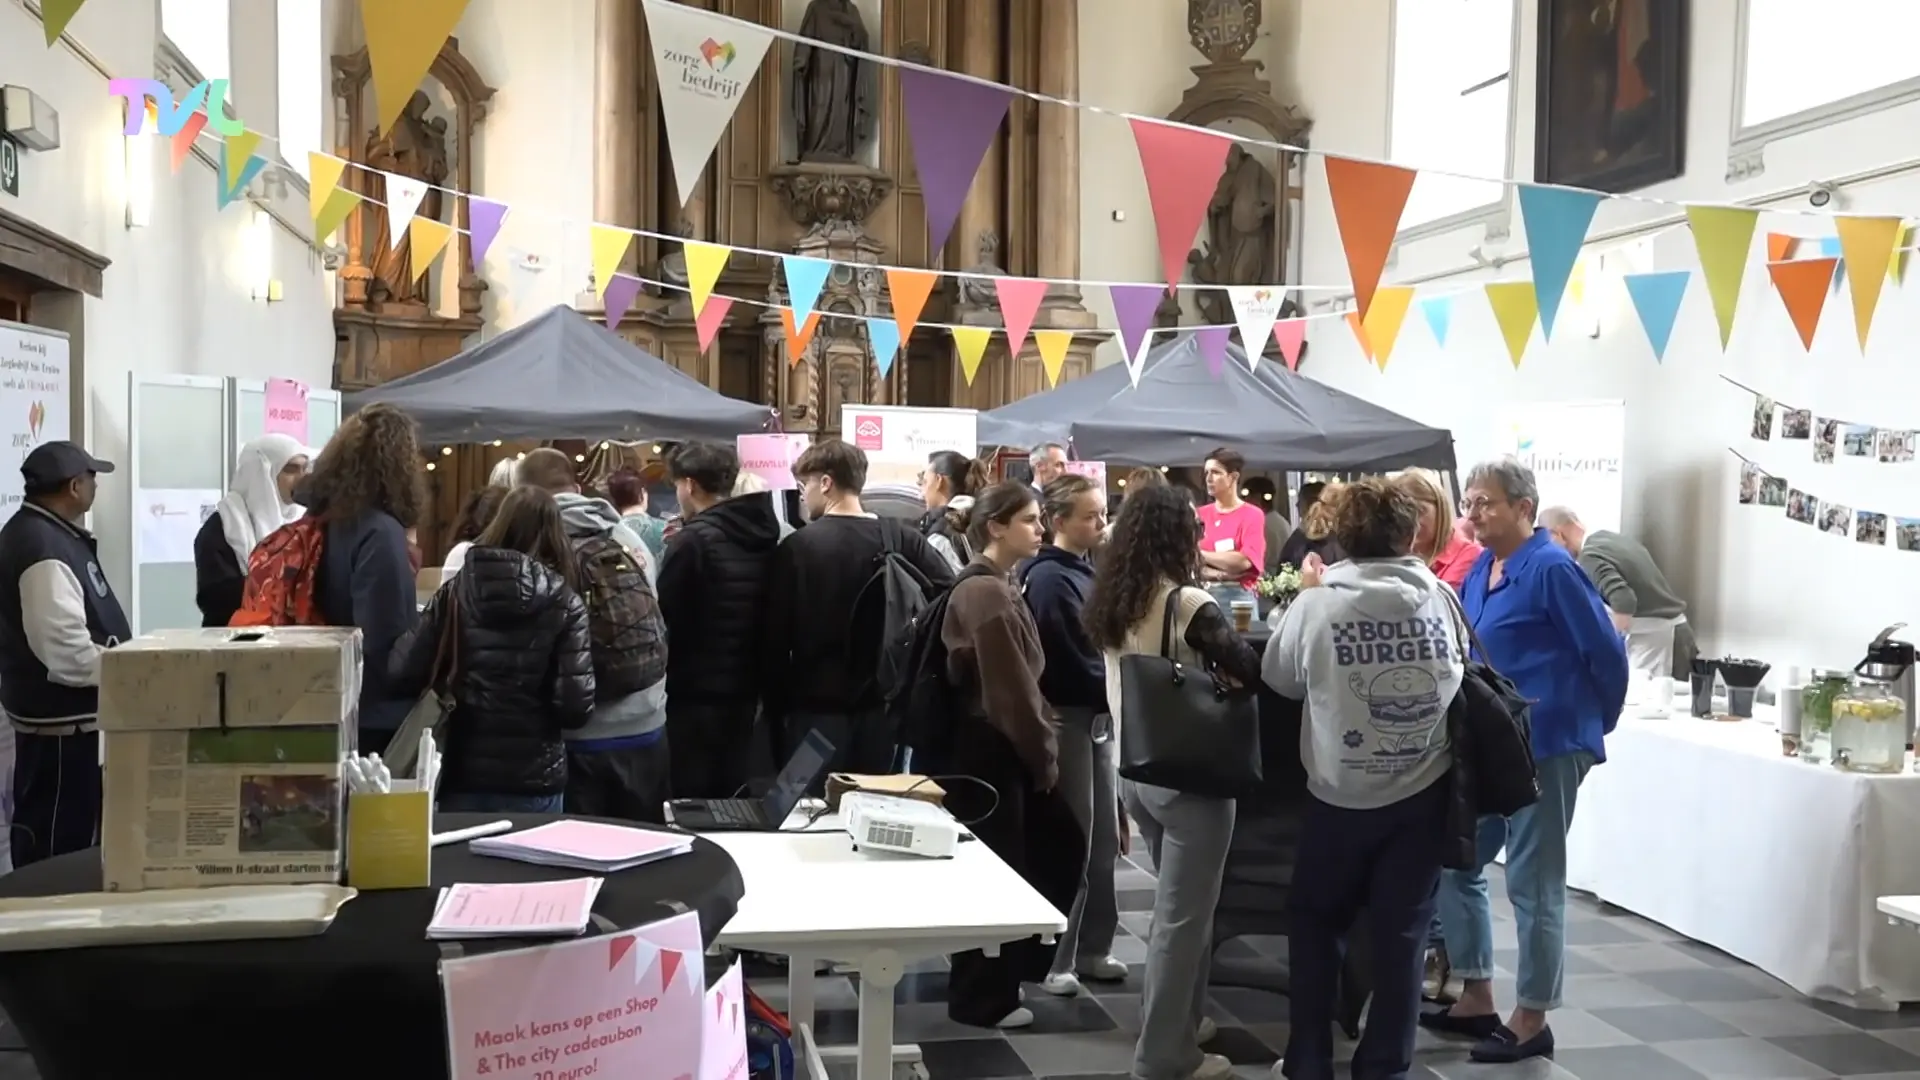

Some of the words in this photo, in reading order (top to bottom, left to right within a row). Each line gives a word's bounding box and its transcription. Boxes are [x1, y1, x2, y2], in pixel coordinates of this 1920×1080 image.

[663, 49, 701, 75] zorg
[682, 67, 742, 100] bedrijf
[1357, 617, 1427, 642] BOLD
[1335, 638, 1449, 666] BURGER
[195, 864, 233, 875] Willem
[283, 864, 321, 873] starten
[474, 1023, 526, 1049] Maak
[530, 1021, 569, 1039] kans
[573, 1014, 593, 1030] op
[597, 1006, 622, 1022] een
[626, 996, 658, 1015] Shop
[476, 1056, 492, 1075] &
[494, 1051, 526, 1071] The
[531, 1045, 560, 1064] city
[563, 1025, 643, 1056] cadeaubon
[556, 1057, 598, 1080] euro!
